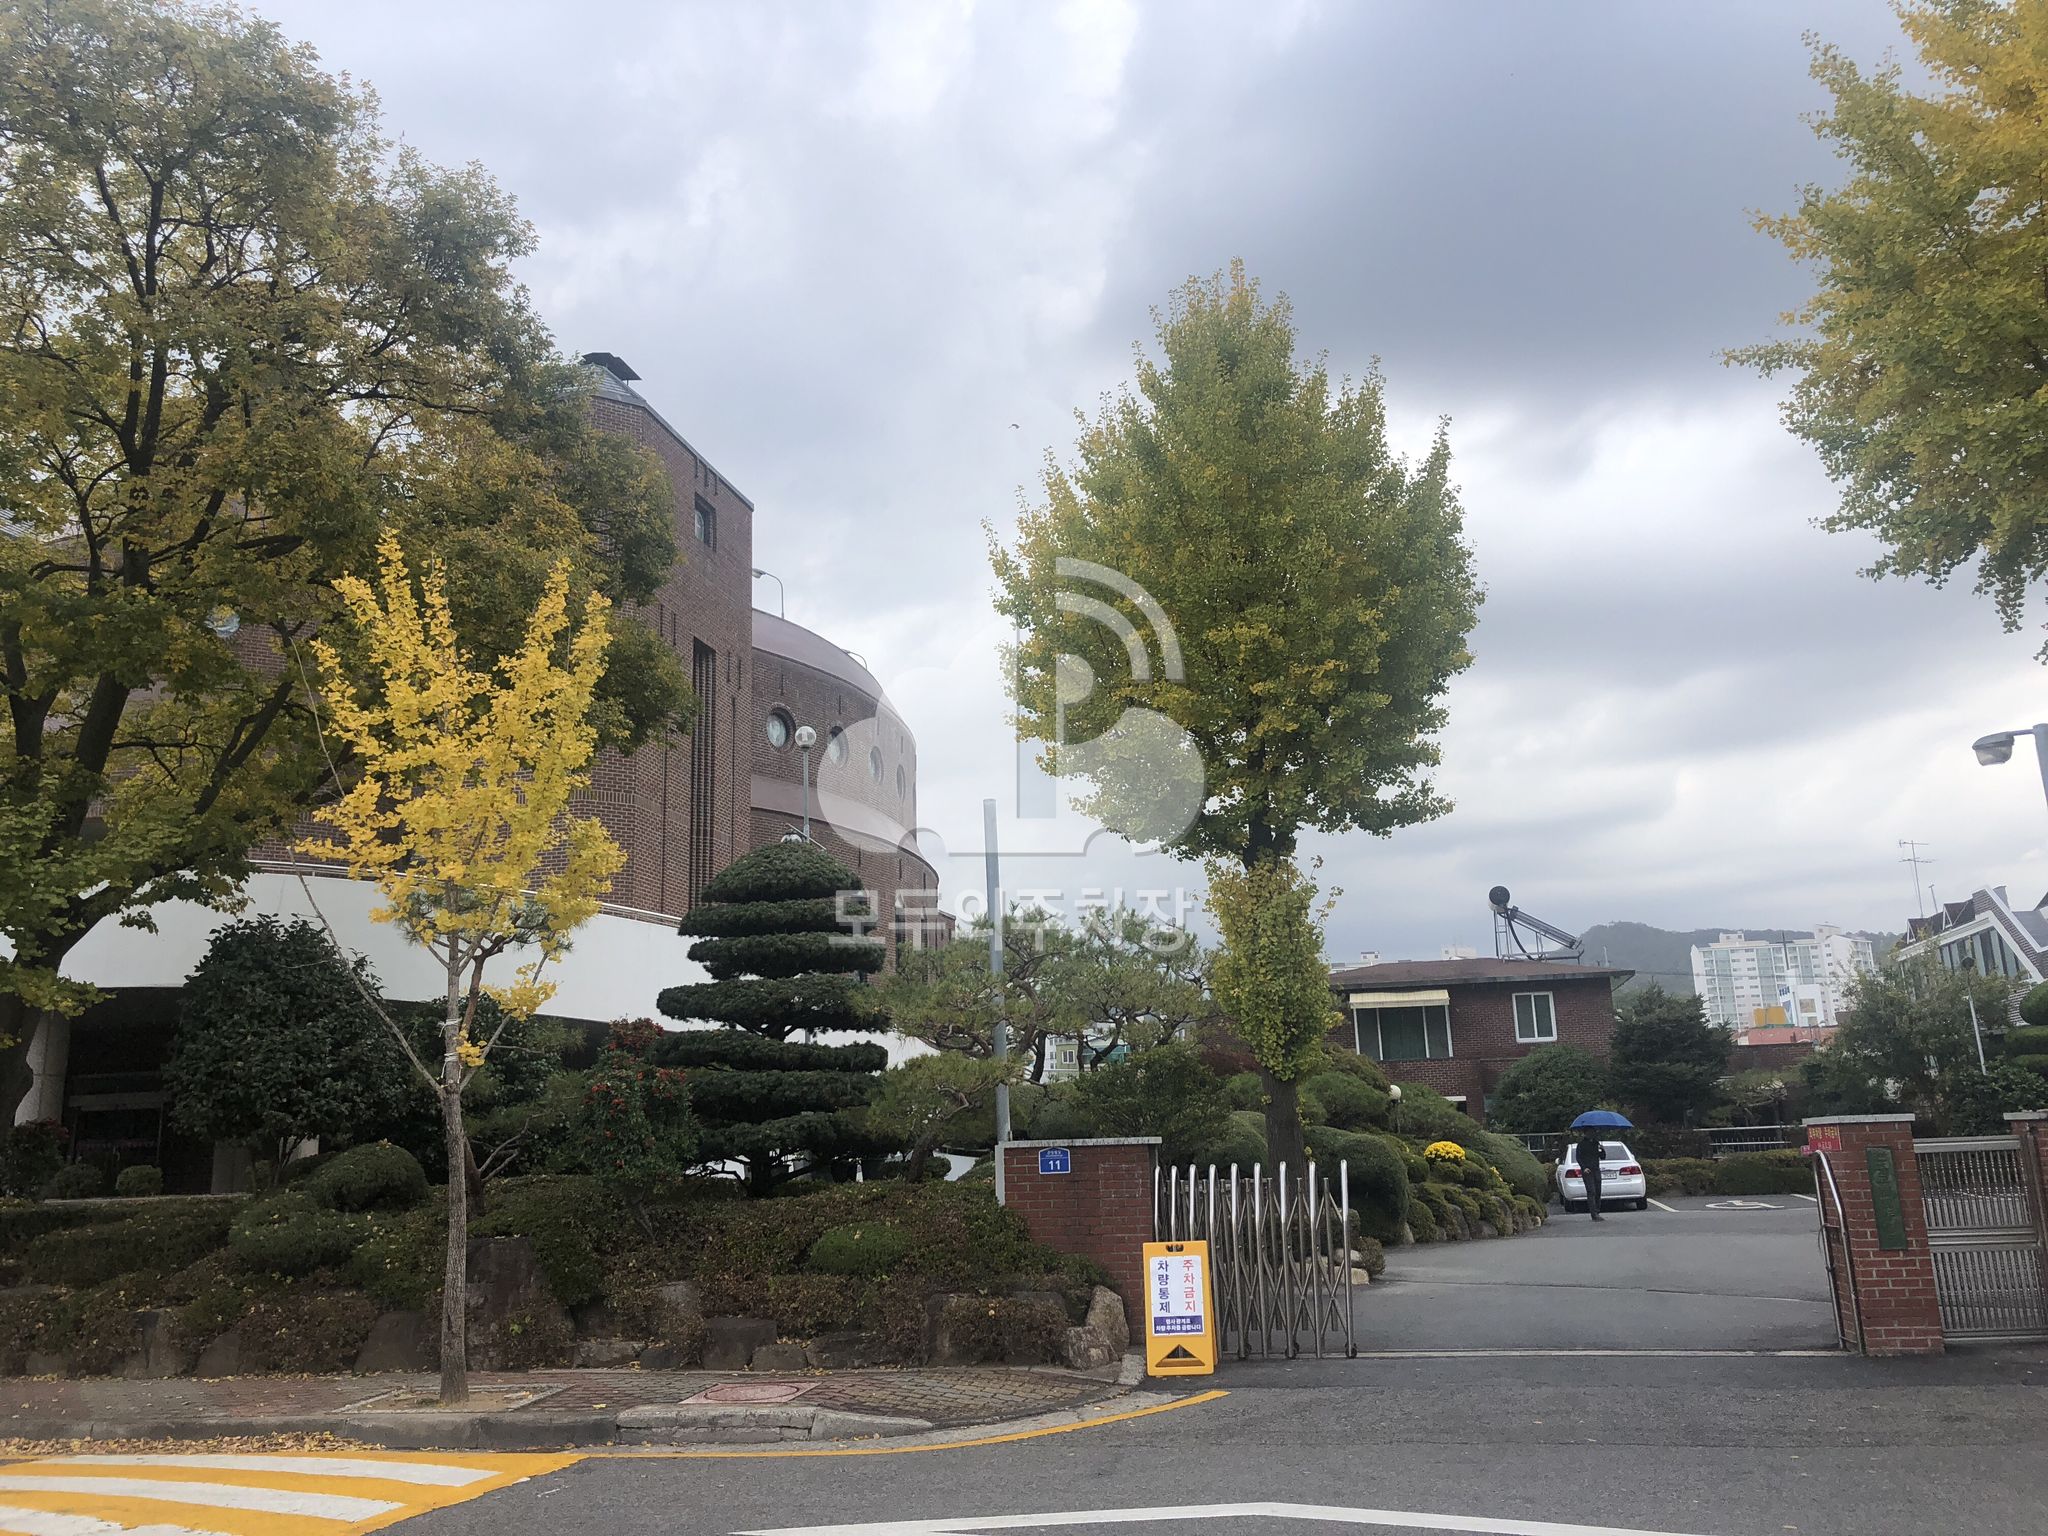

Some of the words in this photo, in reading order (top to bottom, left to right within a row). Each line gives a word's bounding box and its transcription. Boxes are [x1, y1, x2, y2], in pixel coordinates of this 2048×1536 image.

[1049, 1160, 1060, 1170] 11
[1158, 1260, 1170, 1313] 차량통제
[1183, 1259, 1195, 1312] 주차금지
